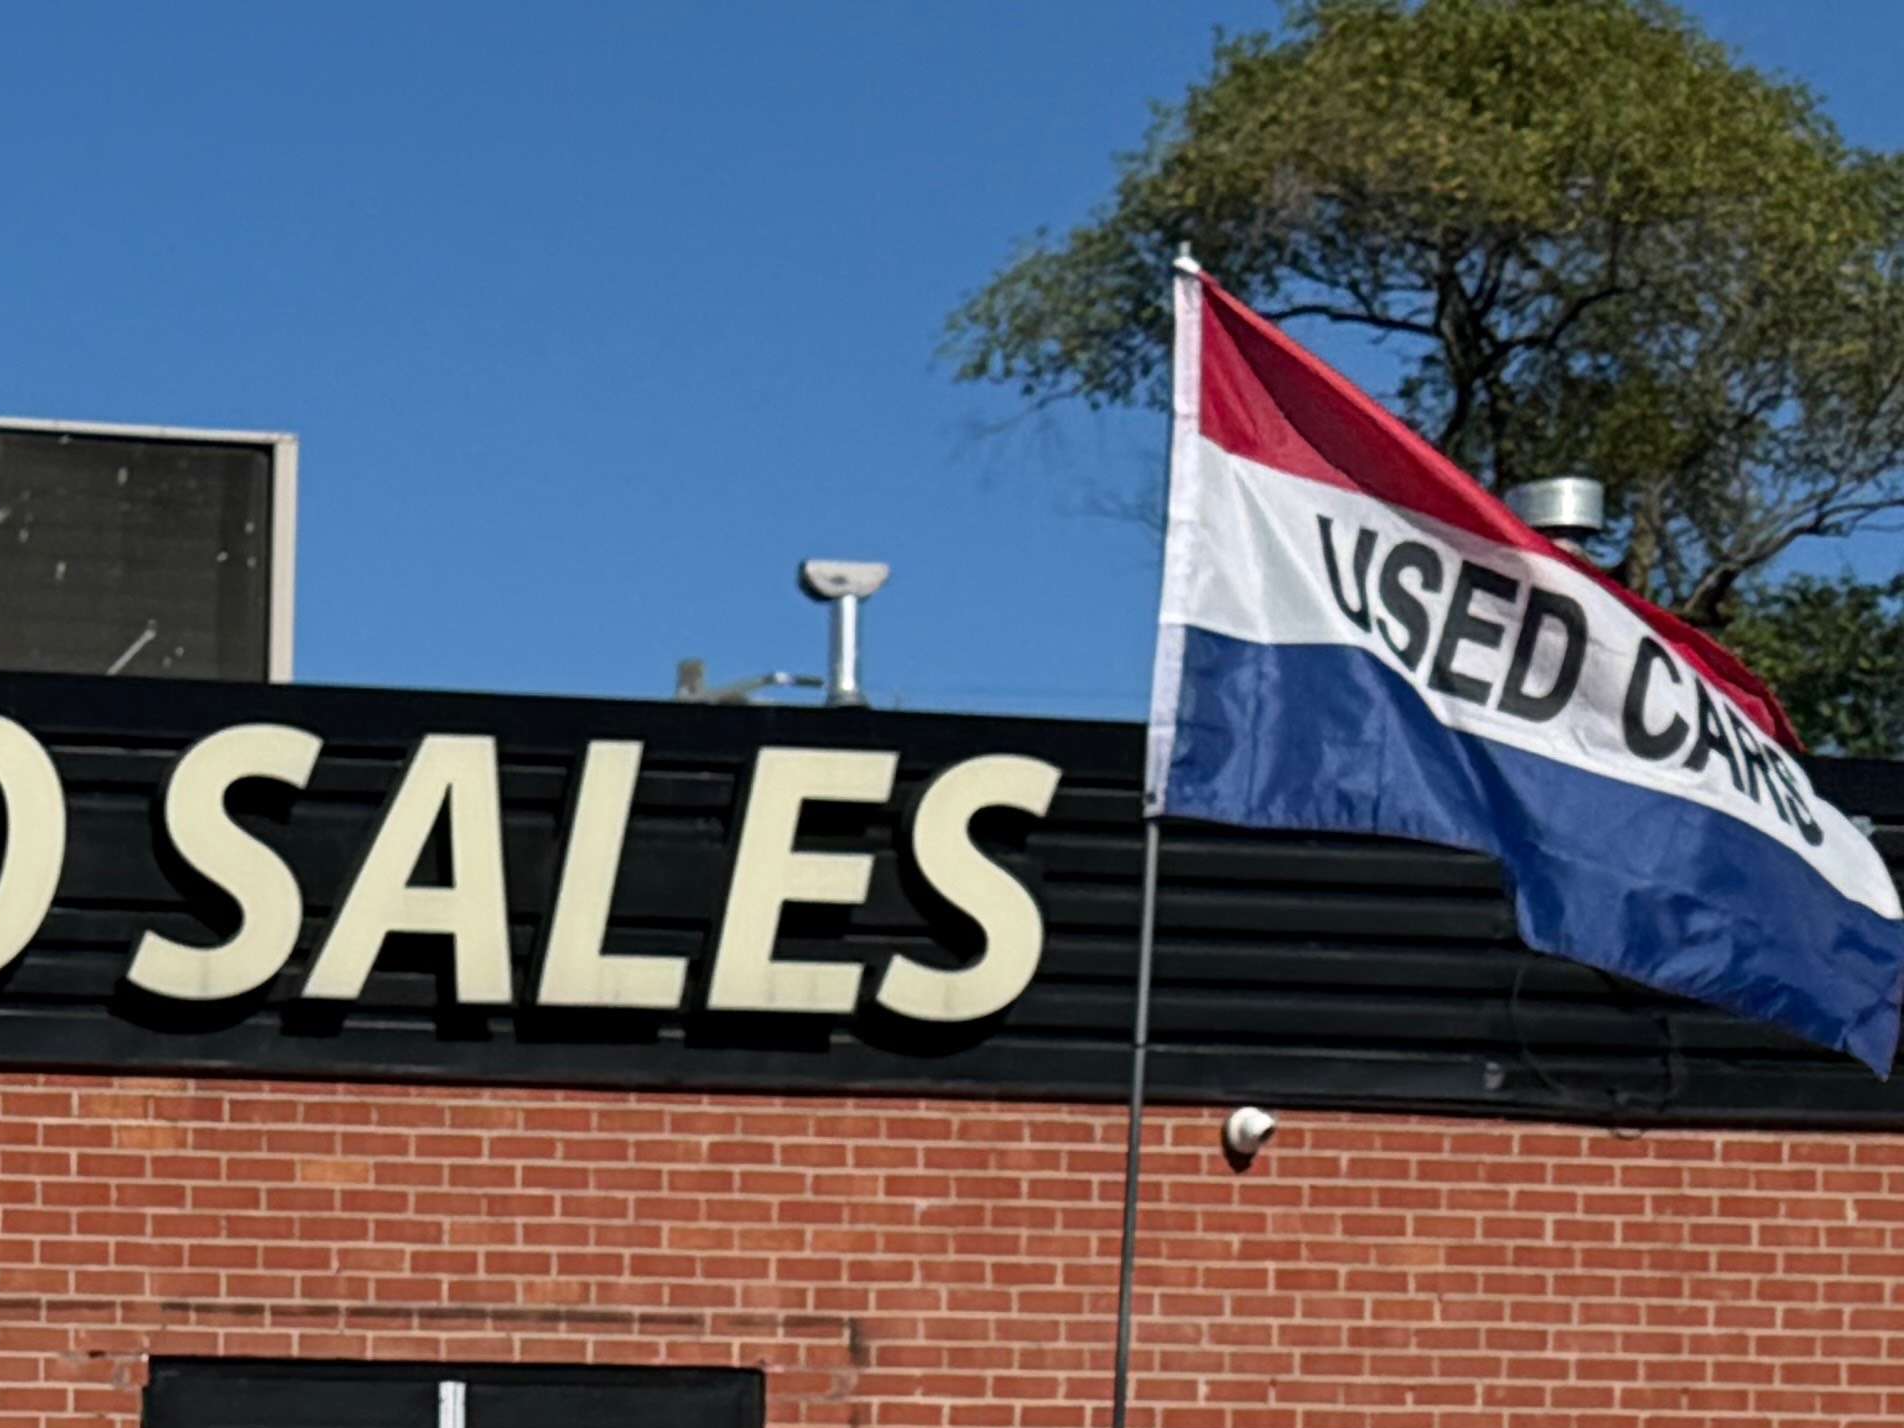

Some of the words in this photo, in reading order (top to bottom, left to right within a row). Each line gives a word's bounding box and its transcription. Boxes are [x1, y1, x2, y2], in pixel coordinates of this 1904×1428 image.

[1316, 512, 1590, 724] USED
[1621, 635, 1824, 847] CARS
[124, 722, 1065, 1023] SALES
